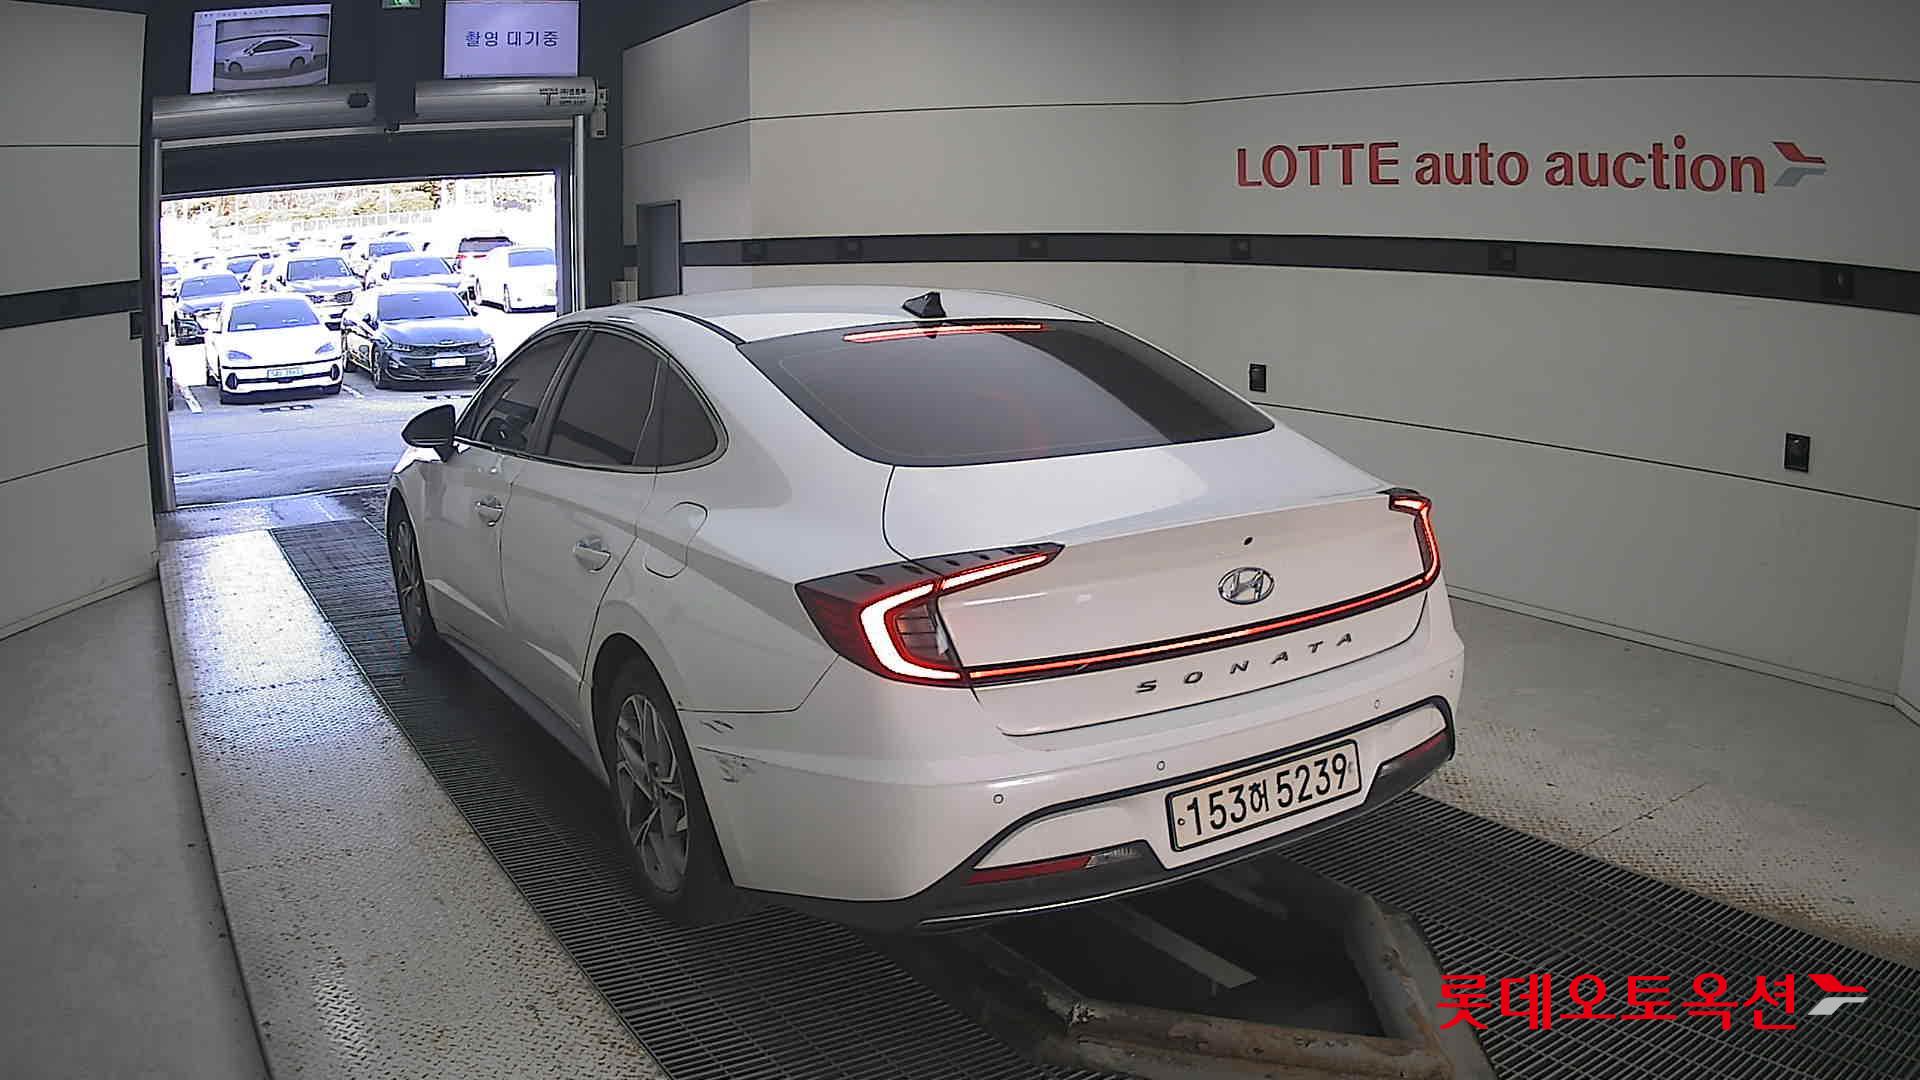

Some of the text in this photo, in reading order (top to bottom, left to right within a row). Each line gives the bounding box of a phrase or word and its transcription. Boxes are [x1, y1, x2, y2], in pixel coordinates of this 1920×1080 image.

[465, 31, 560, 47] 촬영 대기중
[1236, 135, 1765, 194] LOTTE auto auction
[1136, 633, 1352, 693] SONATA
[1187, 753, 1348, 836] 153허 5239
